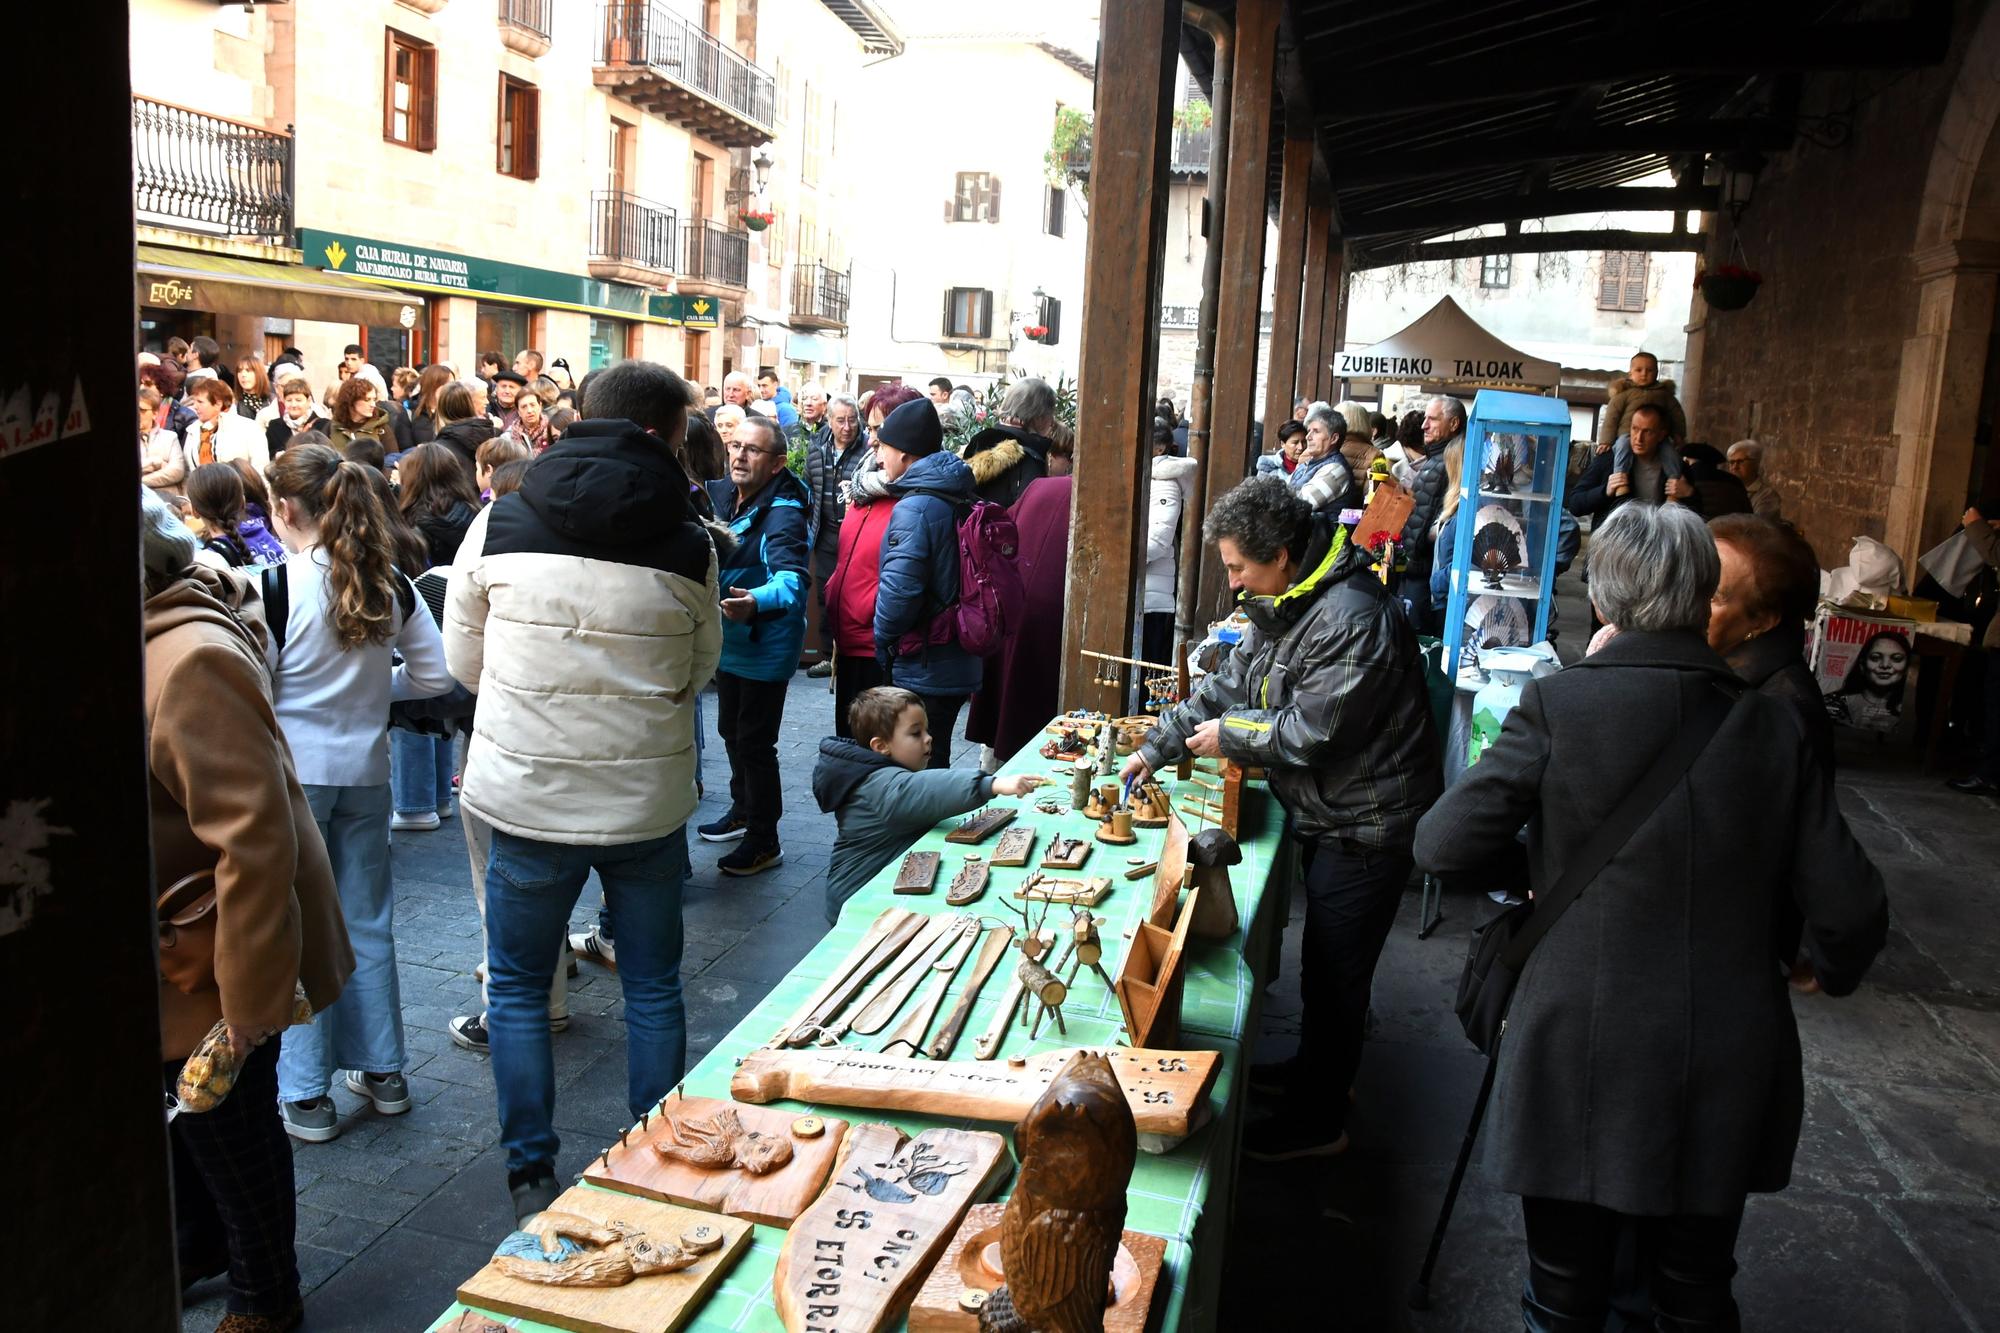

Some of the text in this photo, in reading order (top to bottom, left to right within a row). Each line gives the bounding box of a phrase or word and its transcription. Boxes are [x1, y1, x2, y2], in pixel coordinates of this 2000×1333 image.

[355, 244, 468, 275] CAJA RURAL DE NAVARRA
[355, 261, 468, 287] NAFARROAKO RURAL KUTXA
[1341, 355, 1524, 379] ZUBIETAKO TALOAK
[696, 1226, 710, 1238] 50
